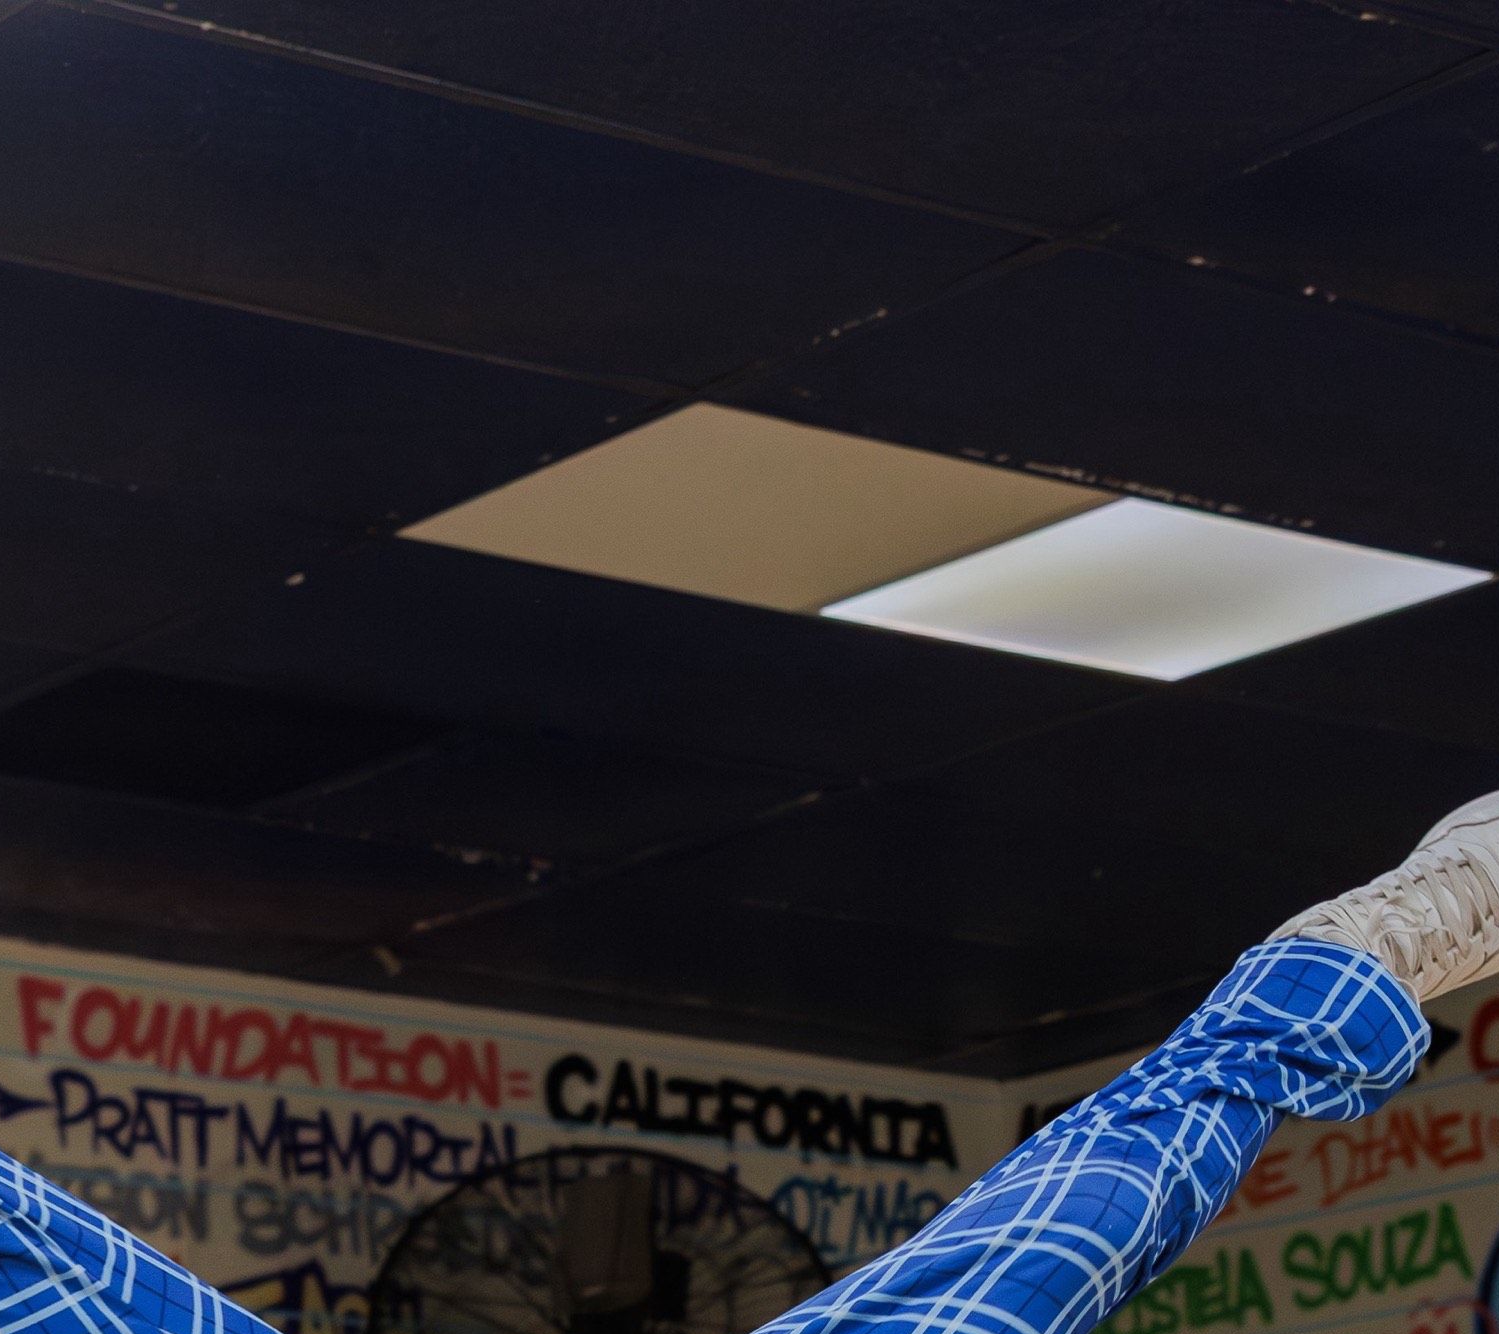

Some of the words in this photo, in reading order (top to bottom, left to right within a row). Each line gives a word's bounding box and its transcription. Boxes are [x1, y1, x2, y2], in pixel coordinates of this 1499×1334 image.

[45, 1068, 230, 1165] PRATT
[545, 1052, 960, 1172] CALIFORNIA
[1282, 1200, 1474, 1310] SOUZA
